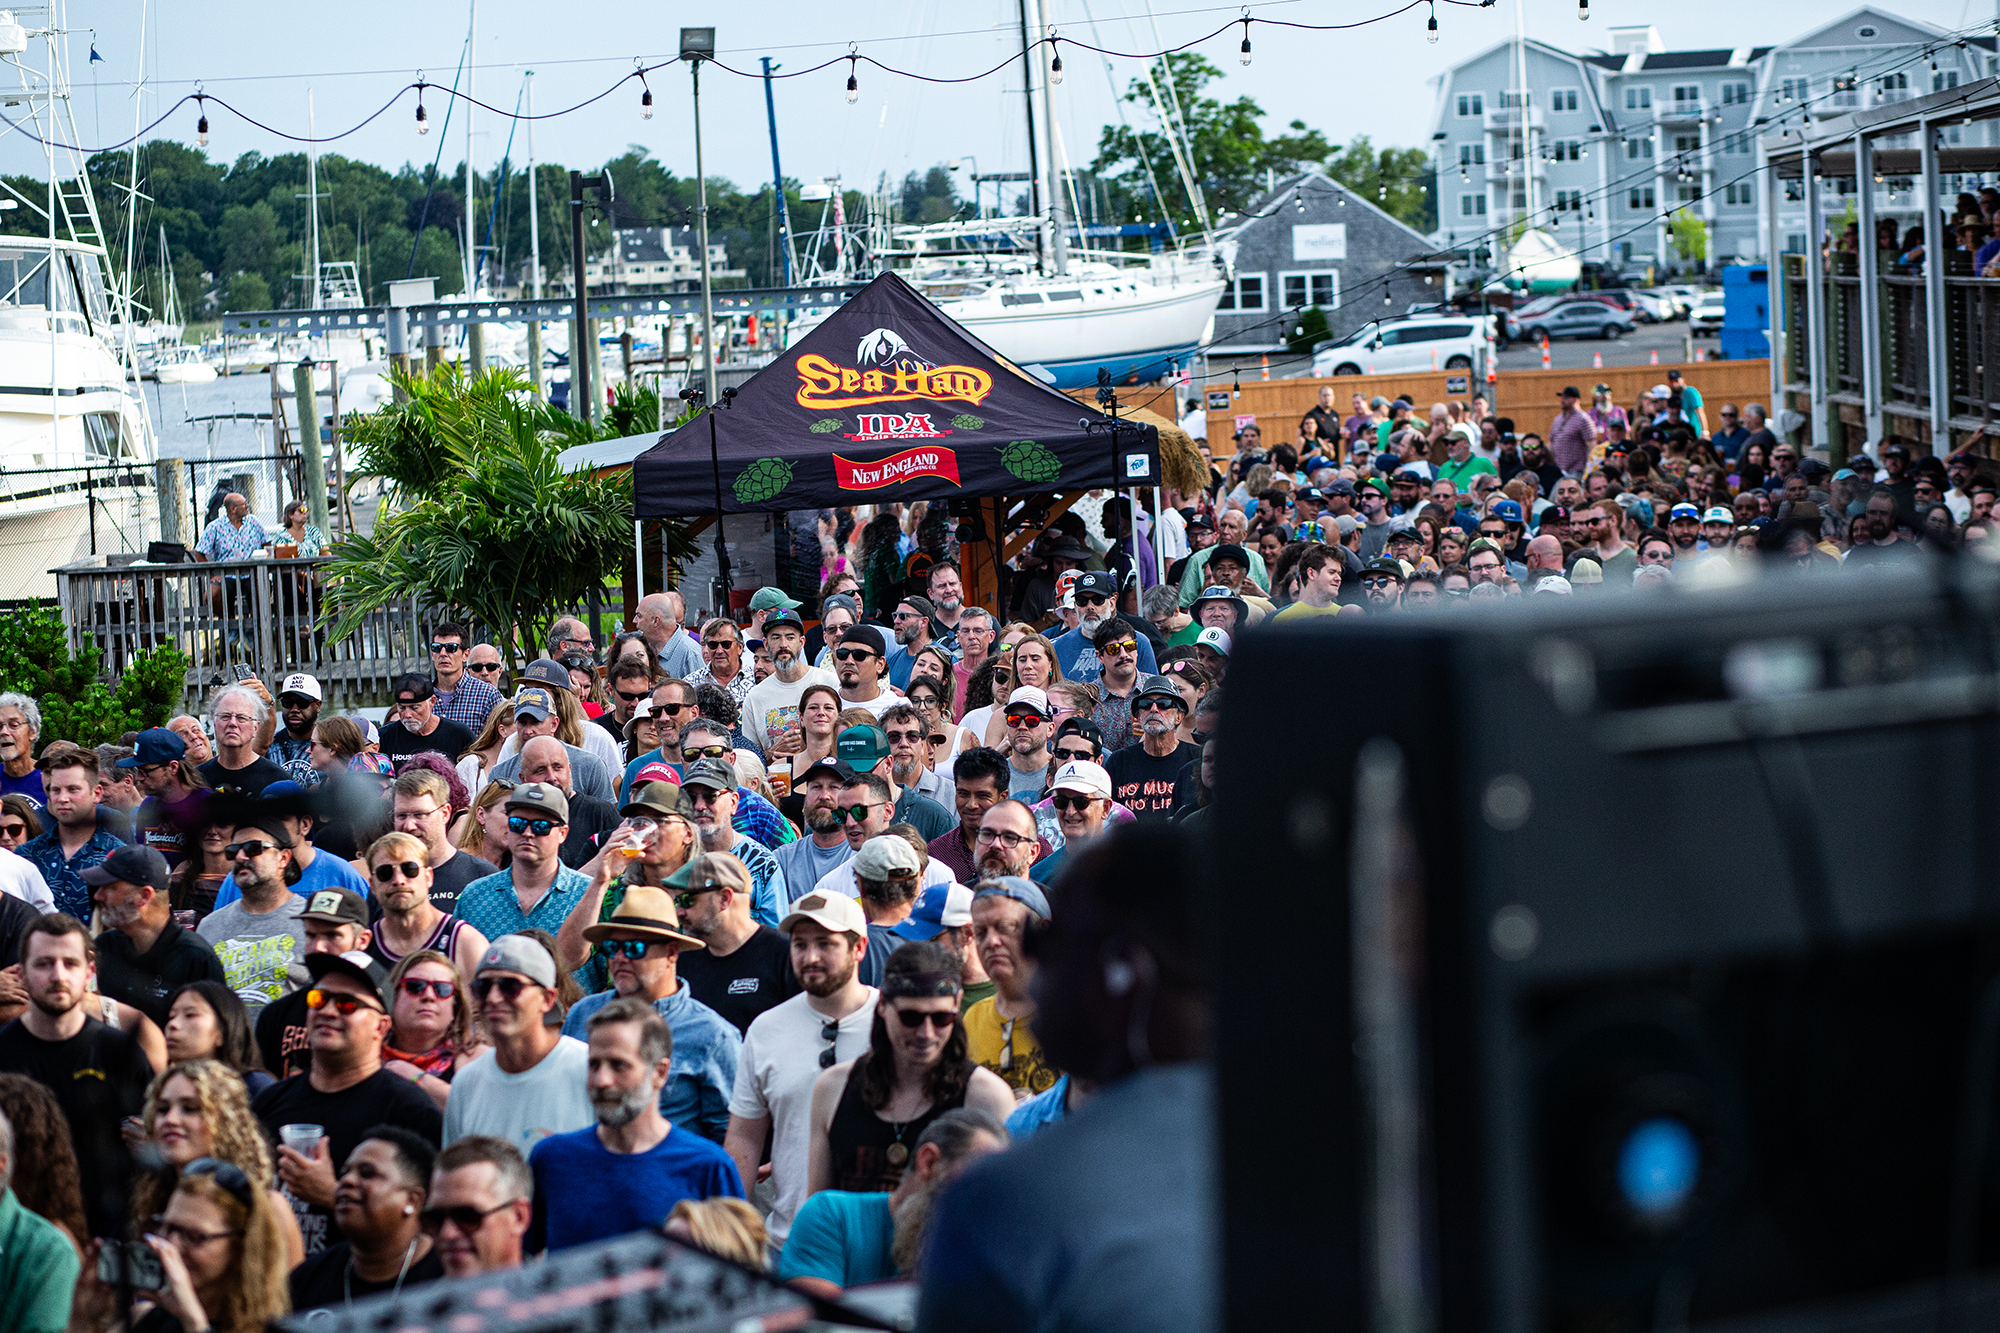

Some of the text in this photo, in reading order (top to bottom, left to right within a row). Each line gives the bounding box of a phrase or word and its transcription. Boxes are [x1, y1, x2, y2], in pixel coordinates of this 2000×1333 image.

[856, 412, 940, 436] IPA
[882, 453, 939, 480] ENGLAND
[1209, 631, 1217, 640] B
[1065, 765, 1076, 775] A
[1118, 783, 1139, 799] NO
[1125, 799, 1146, 811] NO
